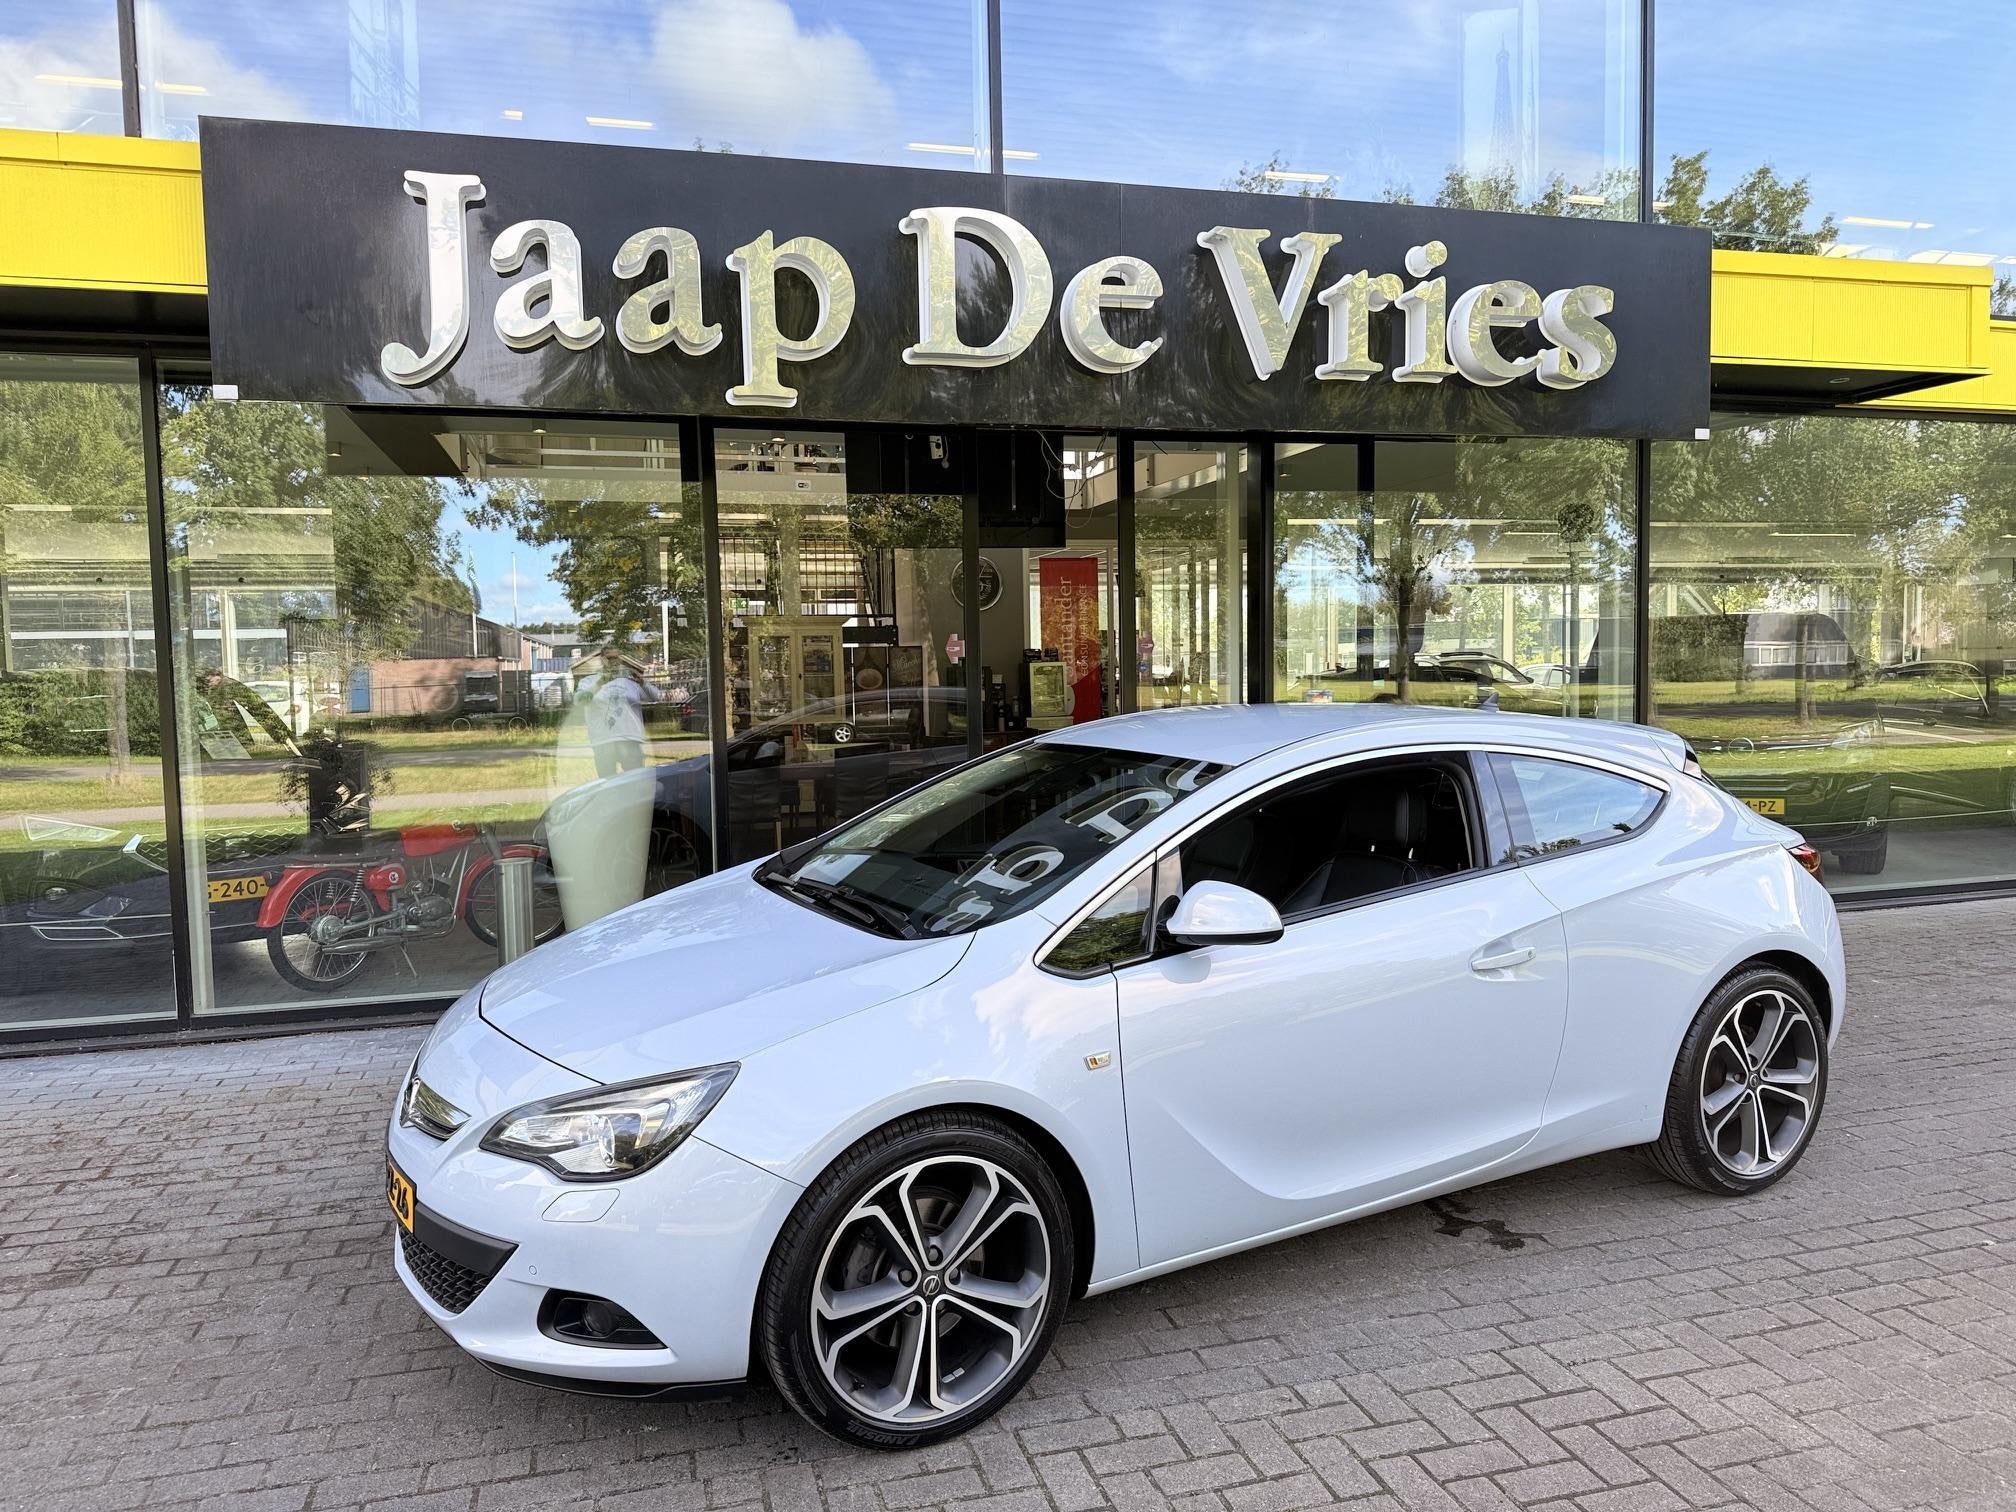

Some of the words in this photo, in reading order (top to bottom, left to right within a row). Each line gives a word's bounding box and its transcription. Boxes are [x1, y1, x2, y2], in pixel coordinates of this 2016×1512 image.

[381, 169, 857, 408] Jaap
[898, 205, 1165, 375] De
[1197, 226, 1618, 389] Vries
